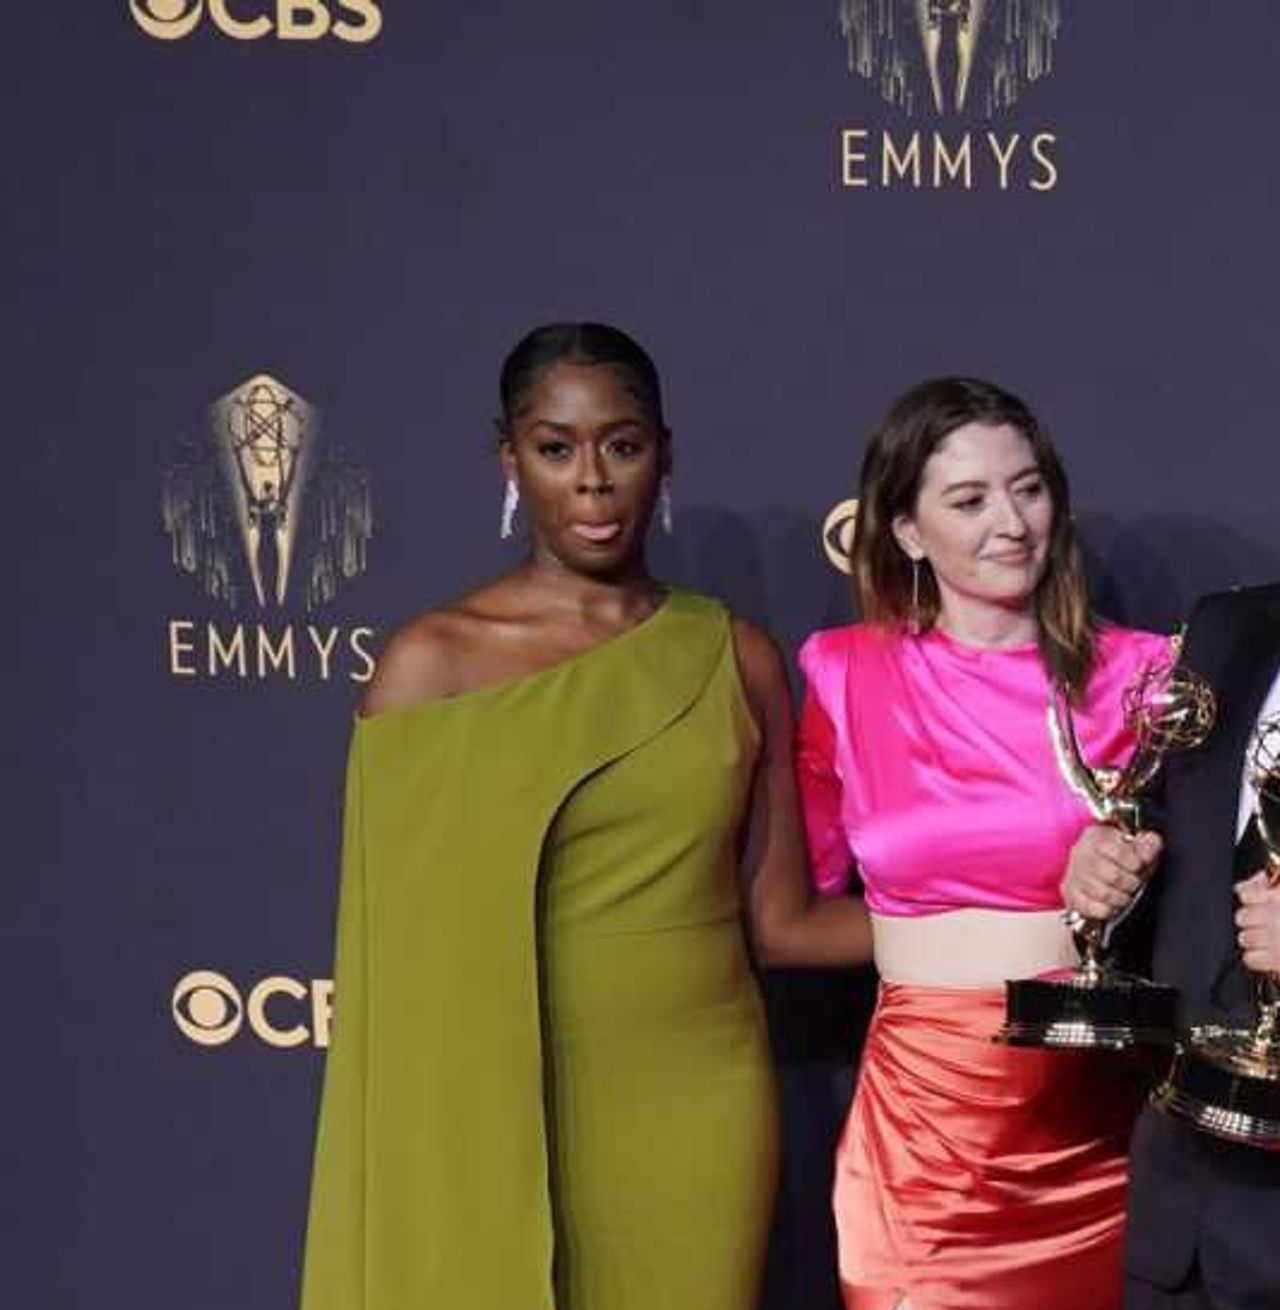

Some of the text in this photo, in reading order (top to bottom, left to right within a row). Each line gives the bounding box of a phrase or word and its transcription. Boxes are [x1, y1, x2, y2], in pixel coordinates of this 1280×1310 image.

[208, 0, 382, 42] CBS
[841, 129, 1058, 191] EMMYS
[169, 619, 375, 683] EMMYS
